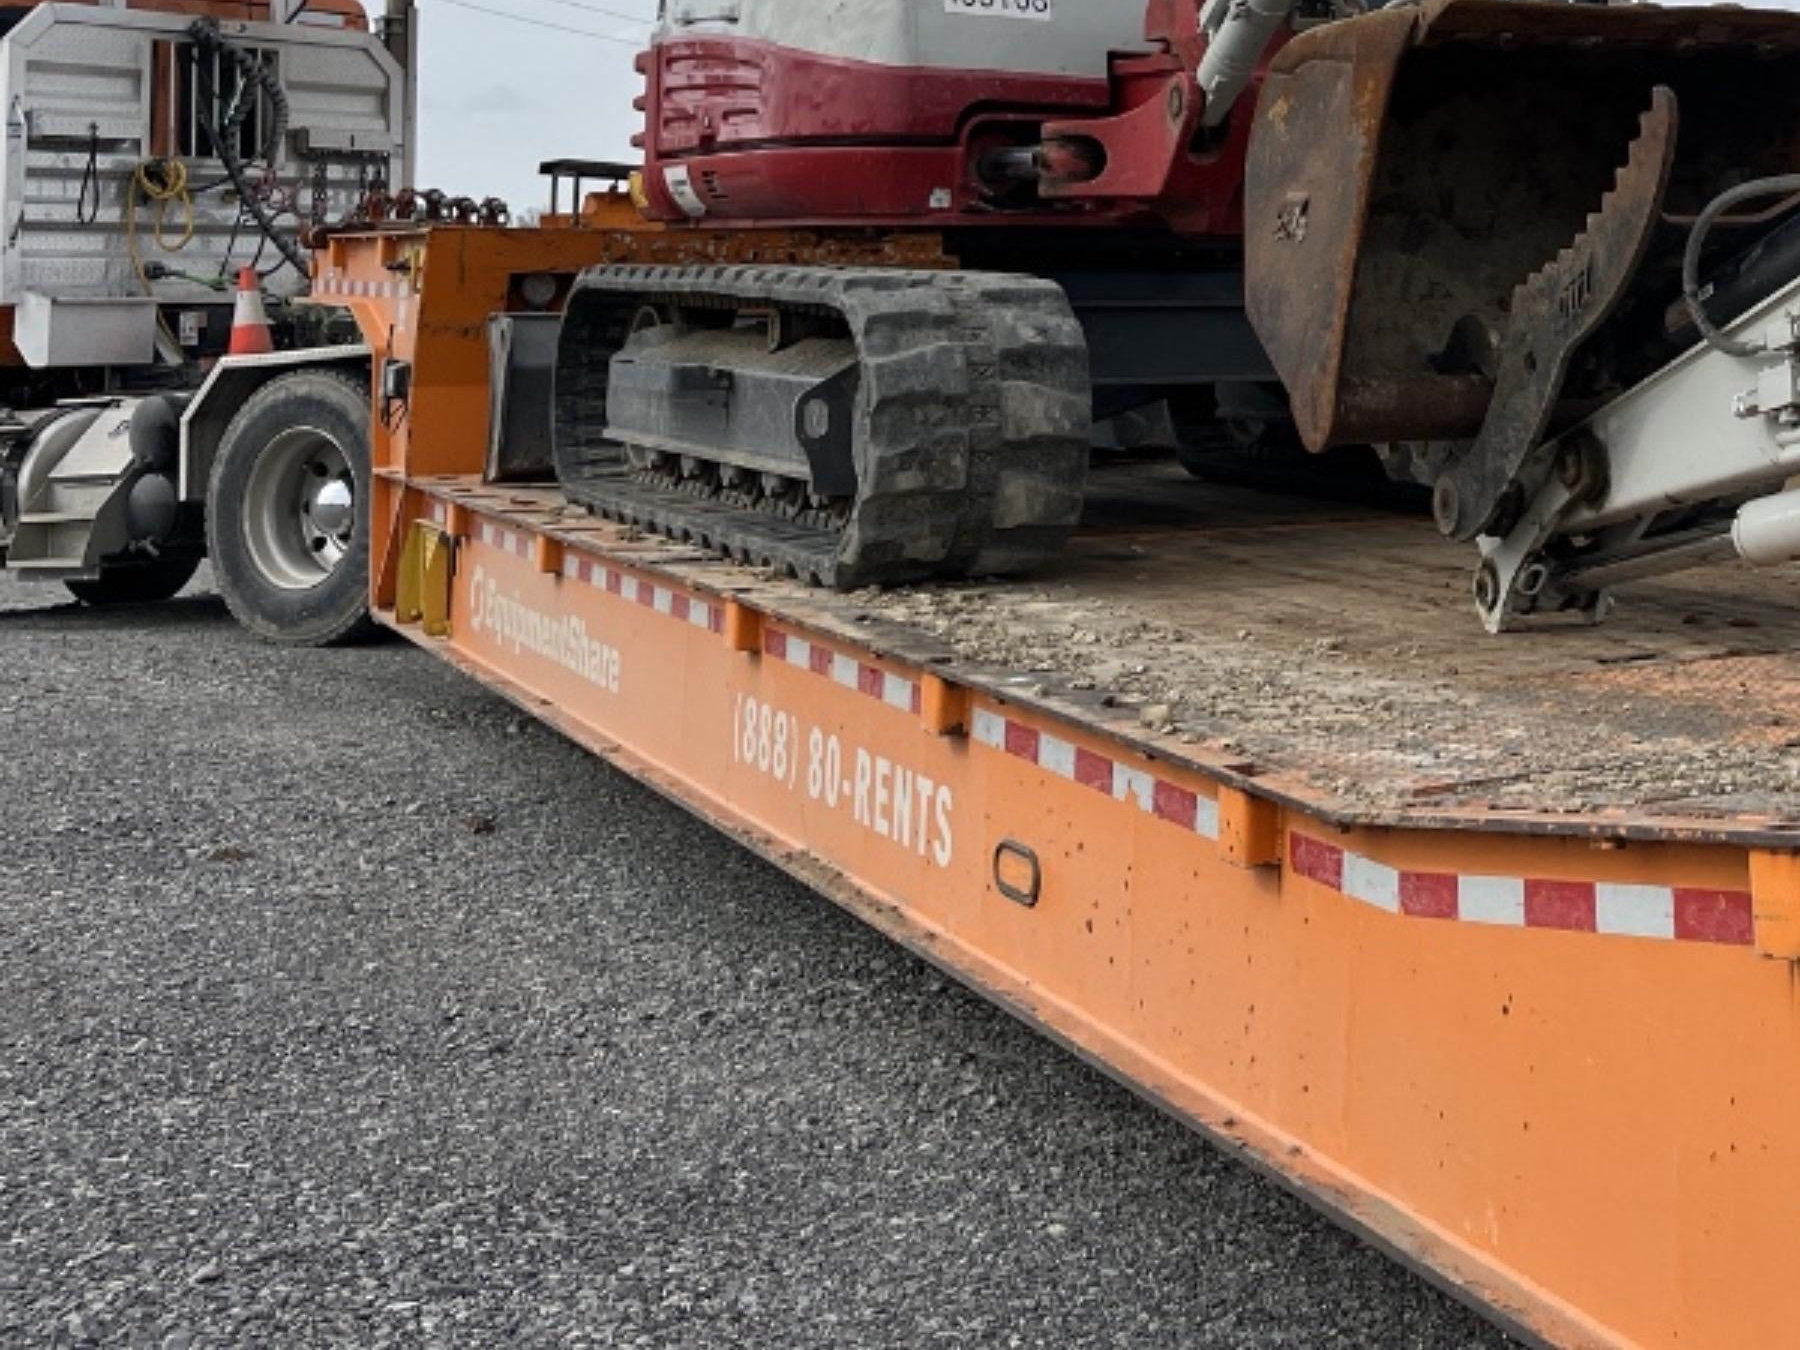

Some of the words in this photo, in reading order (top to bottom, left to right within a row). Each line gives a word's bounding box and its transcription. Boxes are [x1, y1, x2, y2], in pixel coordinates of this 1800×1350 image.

[484, 577, 621, 694] EquipmentShare
[734, 692, 799, 790] (888)
[808, 725, 953, 868] 80-RENTS
